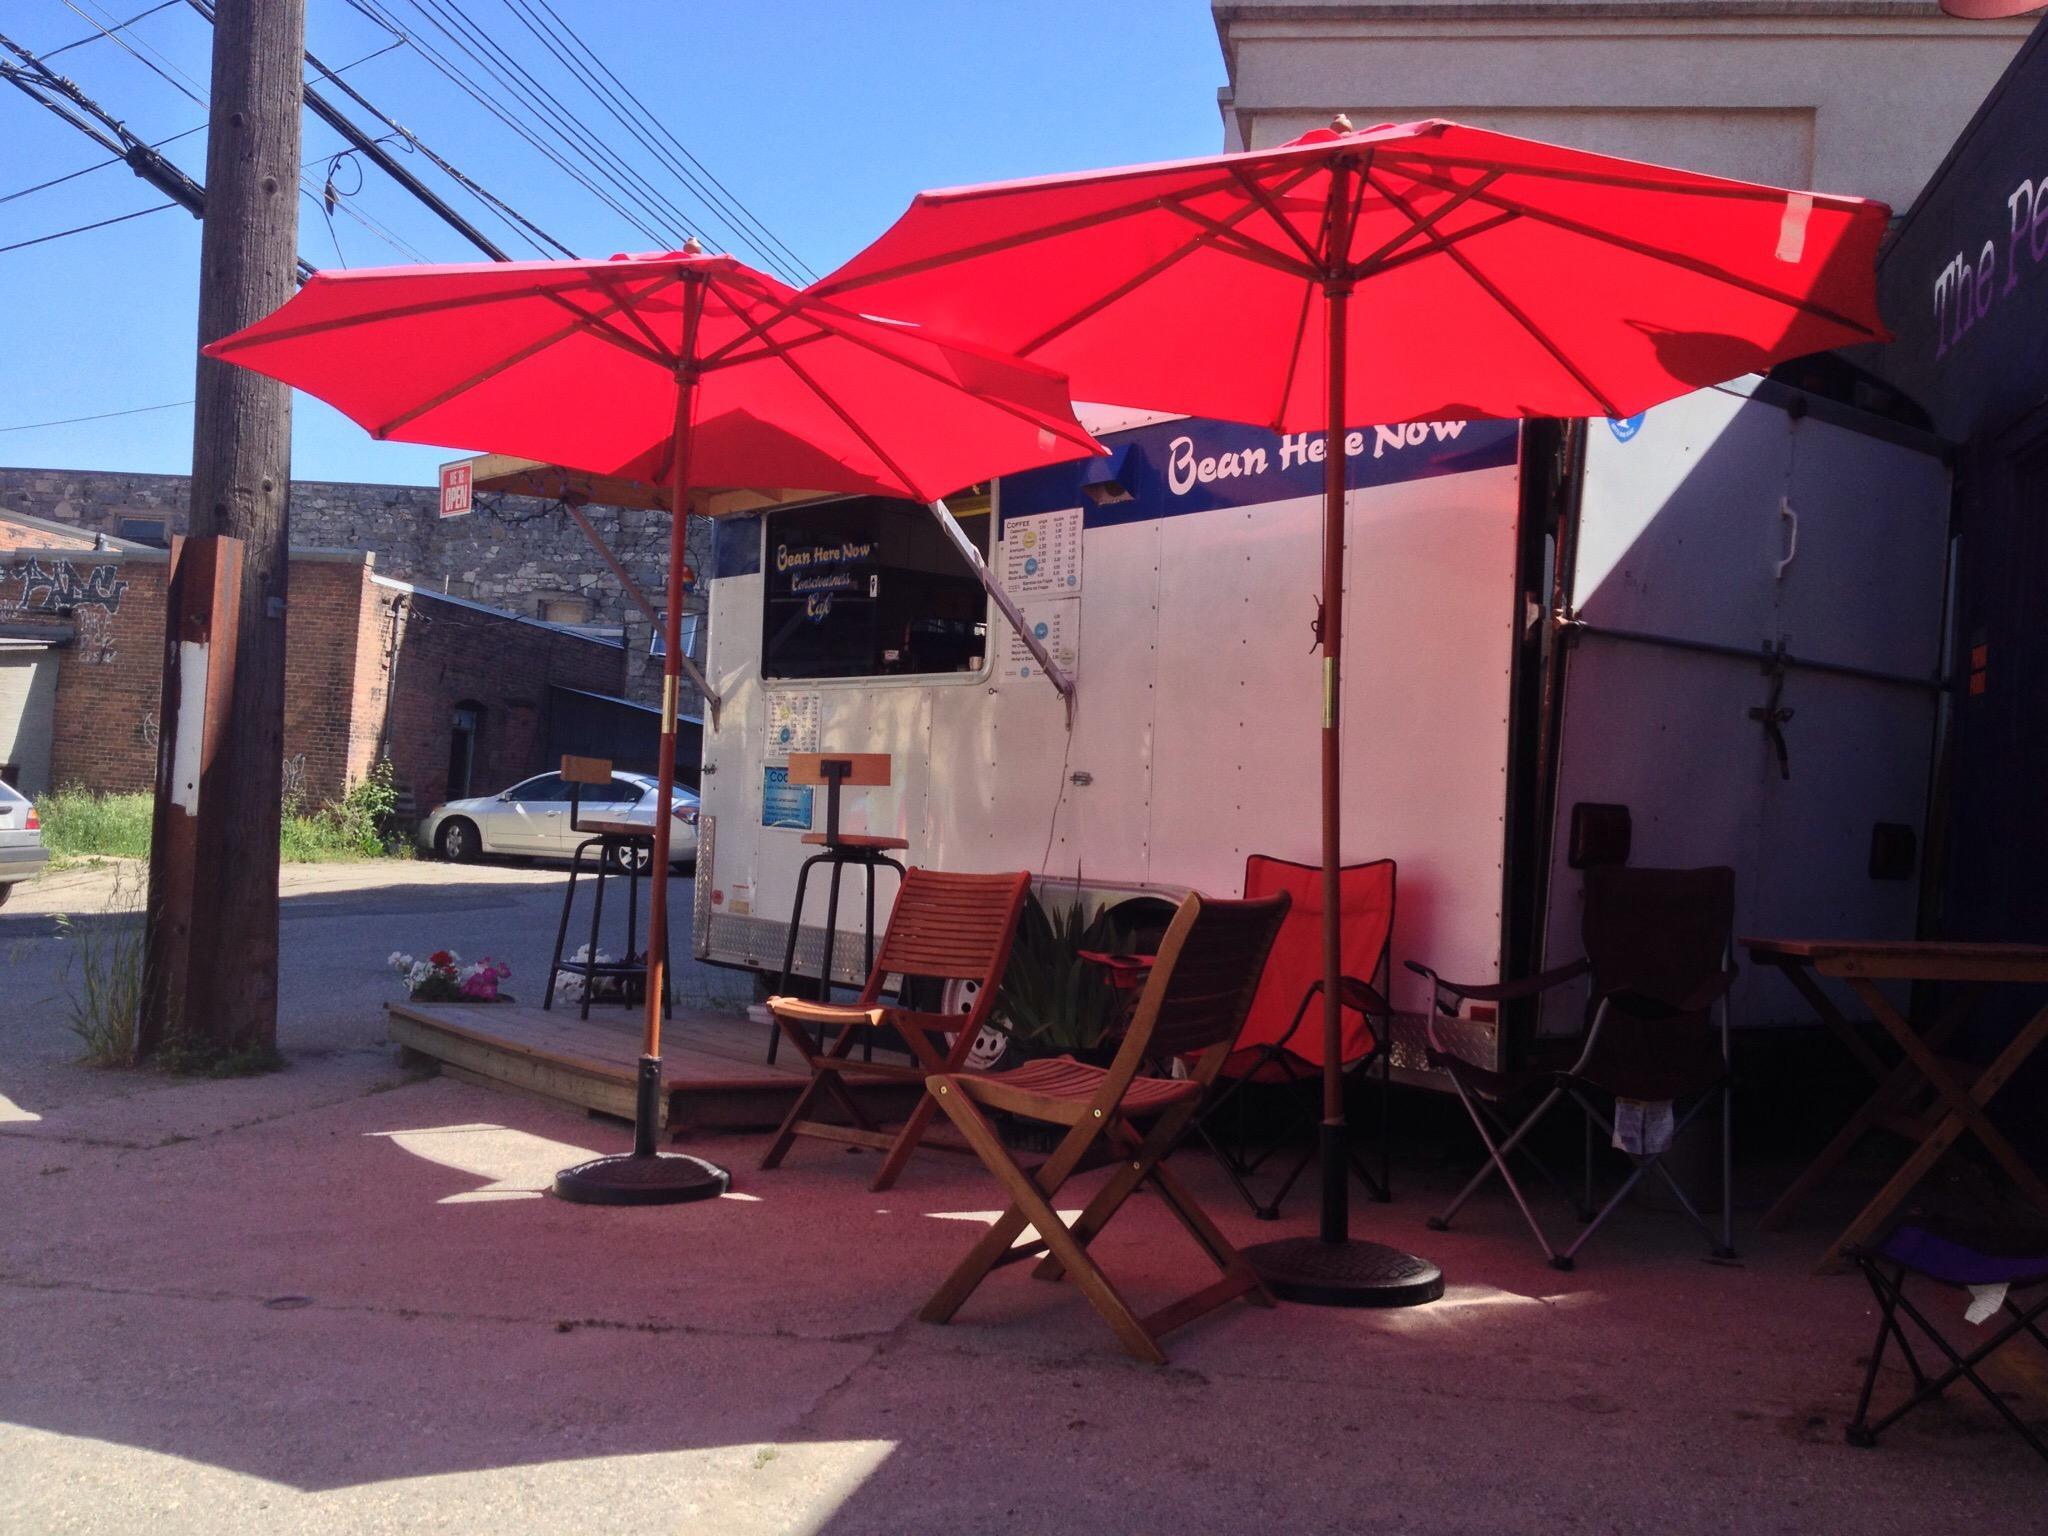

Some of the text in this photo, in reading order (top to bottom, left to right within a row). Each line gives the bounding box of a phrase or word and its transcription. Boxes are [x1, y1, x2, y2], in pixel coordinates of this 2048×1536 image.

[1934, 240, 1995, 361] The
[1168, 420, 1467, 496] Bean Hee Now
[445, 484, 468, 511] OPEN
[1006, 520, 1030, 529] COFFEE
[777, 543, 870, 571] Bean Here Now
